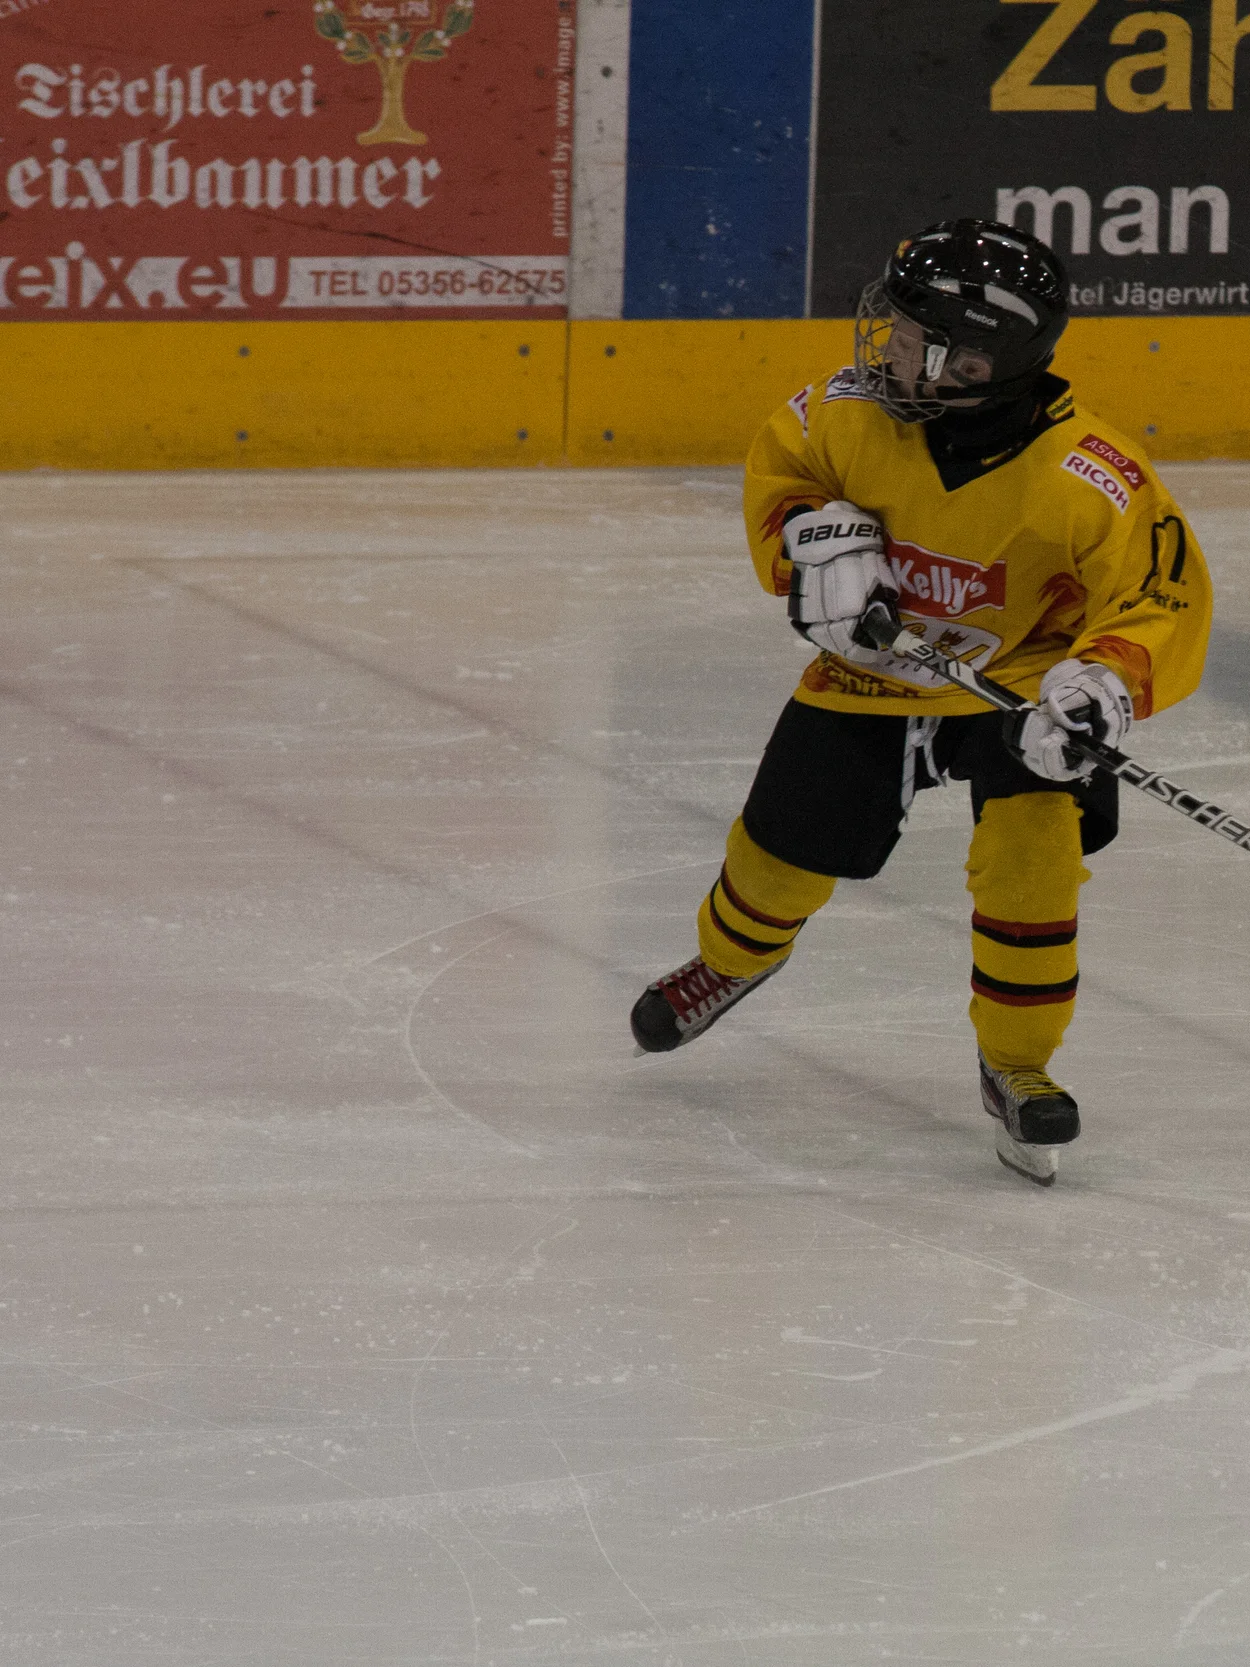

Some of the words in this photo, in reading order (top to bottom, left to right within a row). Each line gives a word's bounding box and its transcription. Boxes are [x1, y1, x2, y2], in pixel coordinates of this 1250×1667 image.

[15, 62, 317, 131] Tischlerei
[0, 138, 442, 209] eixlbaumer
[549, 166, 570, 240] printed
[995, 184, 1230, 254] man
[310, 270, 366, 297] TEL
[378, 269, 565, 296] 05356-62575
[1068, 283, 1104, 305] tel
[1113, 281, 1250, 310] Jägerwirt
[1066, 455, 1128, 509] RICOH
[891, 556, 987, 615] Kelly's
